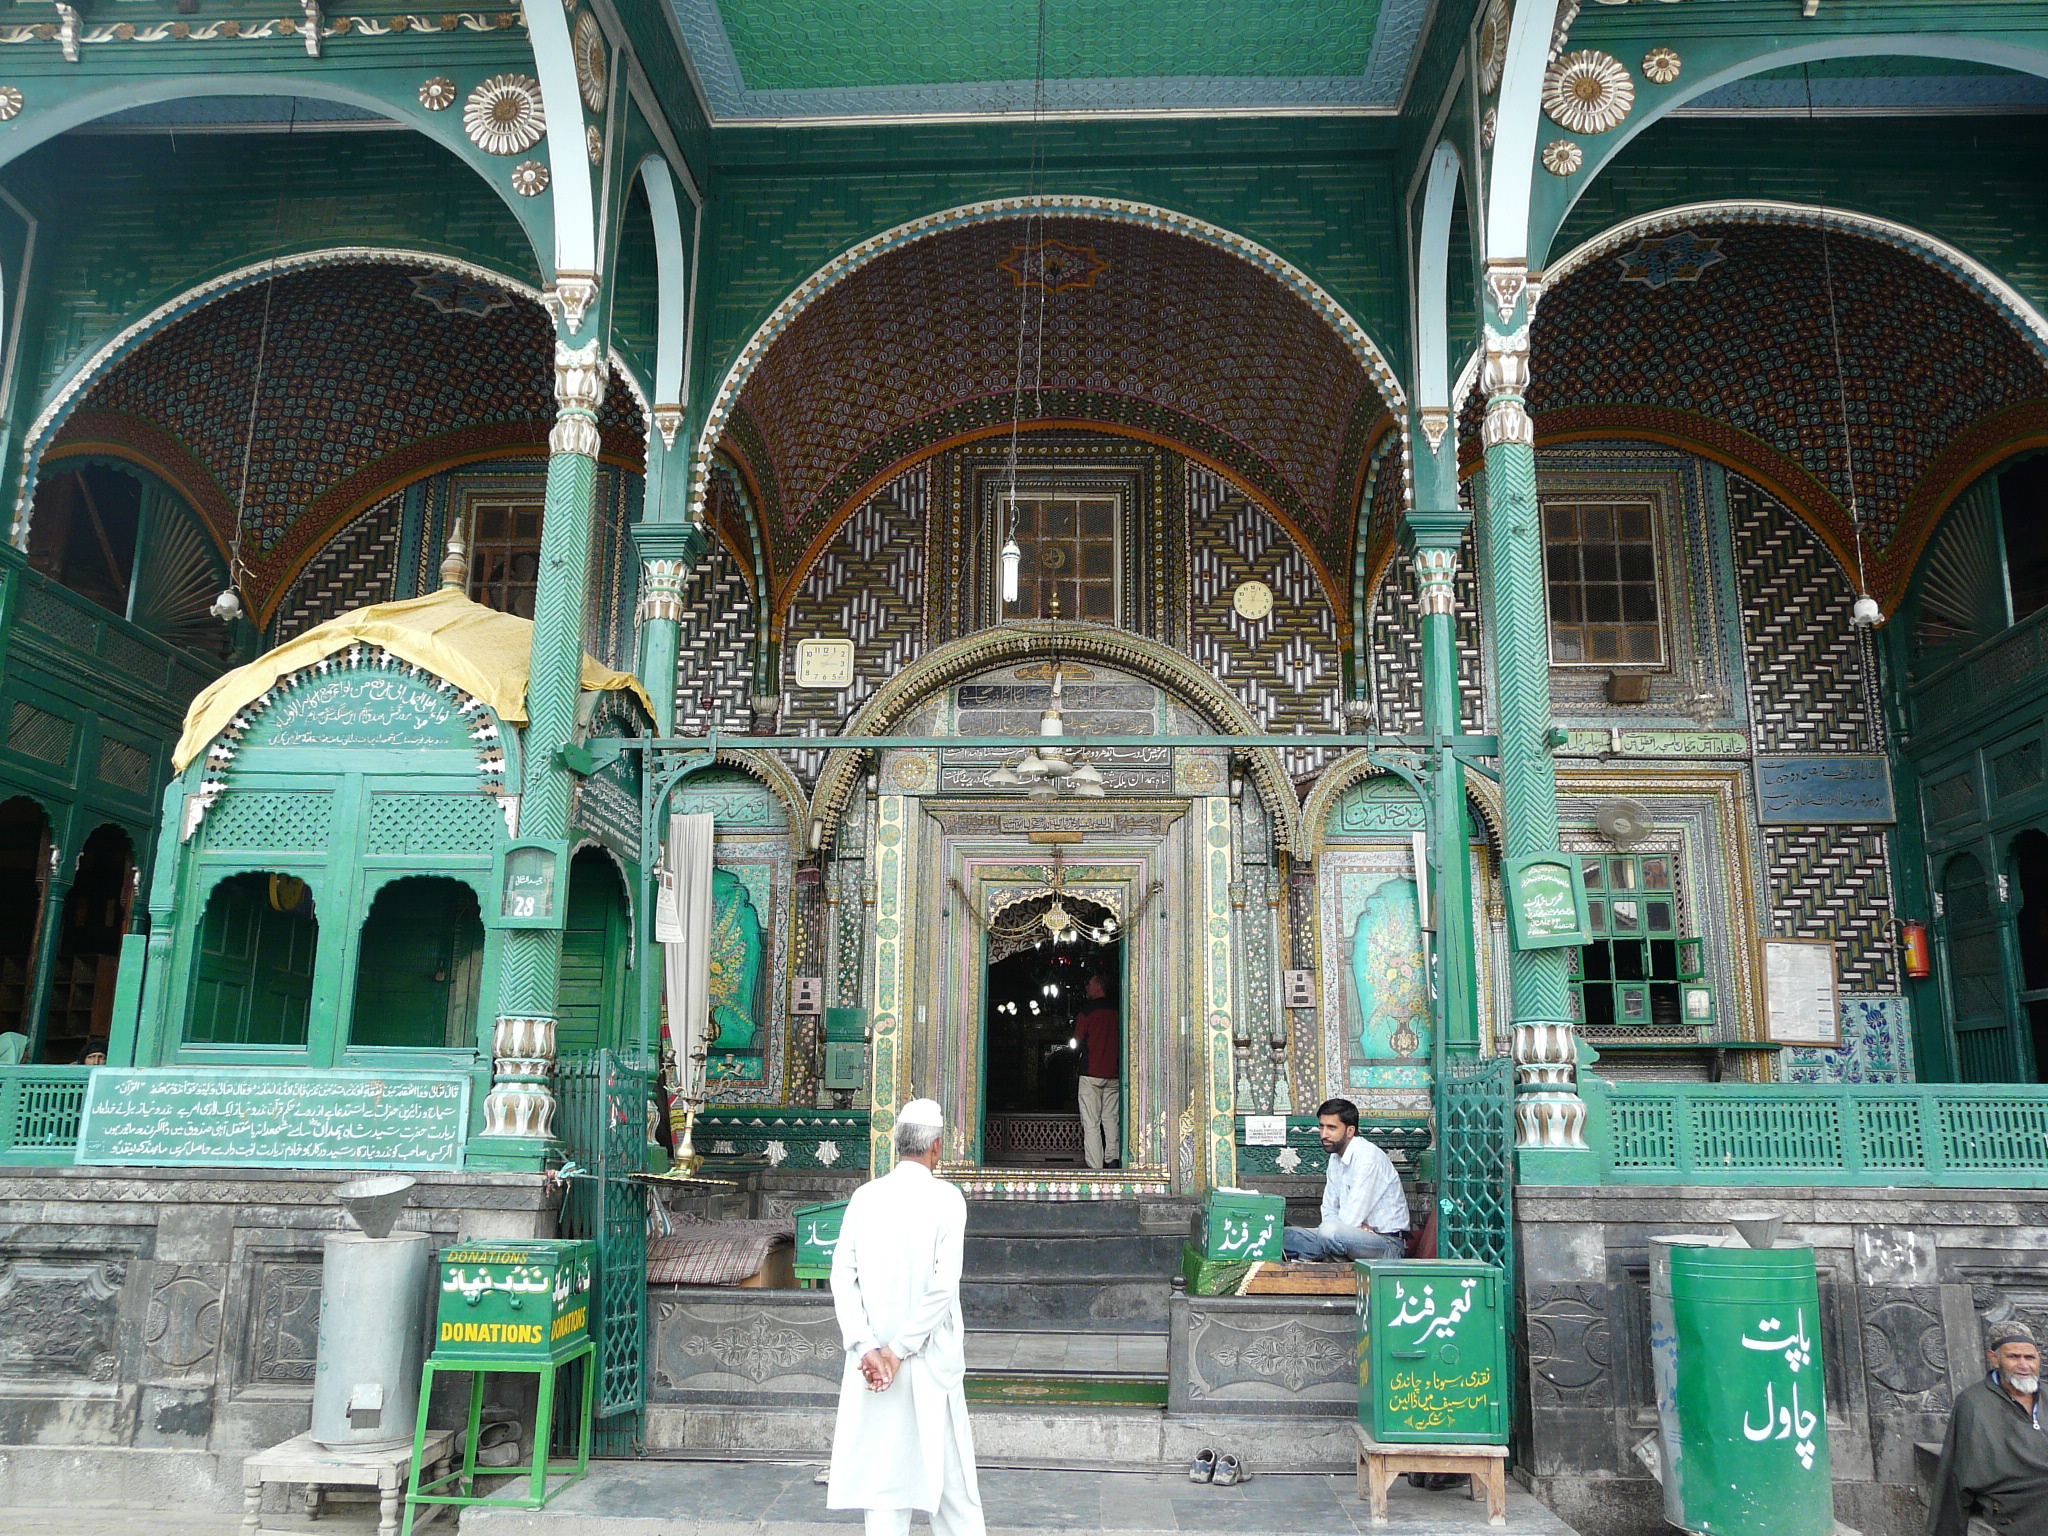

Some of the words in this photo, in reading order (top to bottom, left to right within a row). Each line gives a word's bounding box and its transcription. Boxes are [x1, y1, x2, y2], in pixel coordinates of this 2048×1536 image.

[513, 896, 535, 917] 28
[370, 1126, 400, 1140] سید
[400, 1126, 428, 1143] حضرت
[428, 1125, 456, 1140] زیارت
[398, 1144, 428, 1160] صاحب
[440, 1143, 453, 1162] اگر
[1218, 1218, 1249, 1250] فنڈ
[1242, 1214, 1275, 1258] تعمیر
[446, 1250, 529, 1264] DONATIONS
[1388, 1280, 1436, 1327] فنڈ
[1412, 1278, 1477, 1345] تعمیر
[441, 1322, 543, 1344] DONATIONS
[550, 1306, 586, 1342] DONATIONS
[1390, 1370, 1422, 1394] چاندی
[1425, 1380, 1432, 1390] و
[1433, 1370, 1462, 1390] سونا
[1430, 1396, 1469, 1412] سیف
[1468, 1394, 1488, 1410] اس
[1743, 1381, 1817, 1470] چاول
